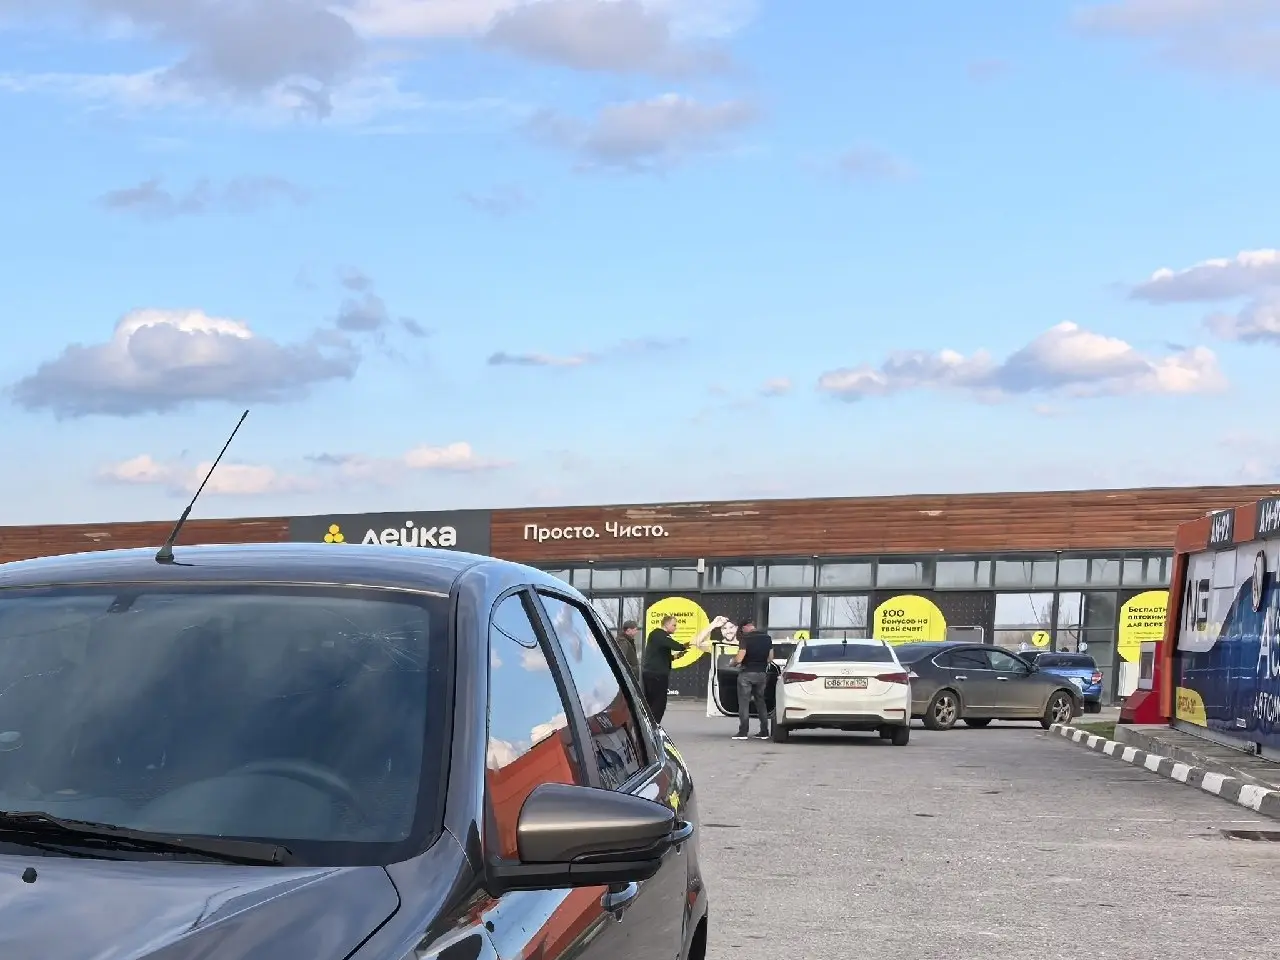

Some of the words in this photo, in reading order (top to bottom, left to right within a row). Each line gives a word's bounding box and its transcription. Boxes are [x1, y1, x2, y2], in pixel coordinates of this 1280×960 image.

[361, 520, 457, 547] лейка
[524, 523, 600, 542] Просто.
[605, 521, 669, 539] Чисто.
[882, 609, 905, 618] 200
[1038, 634, 1045, 643] 7
